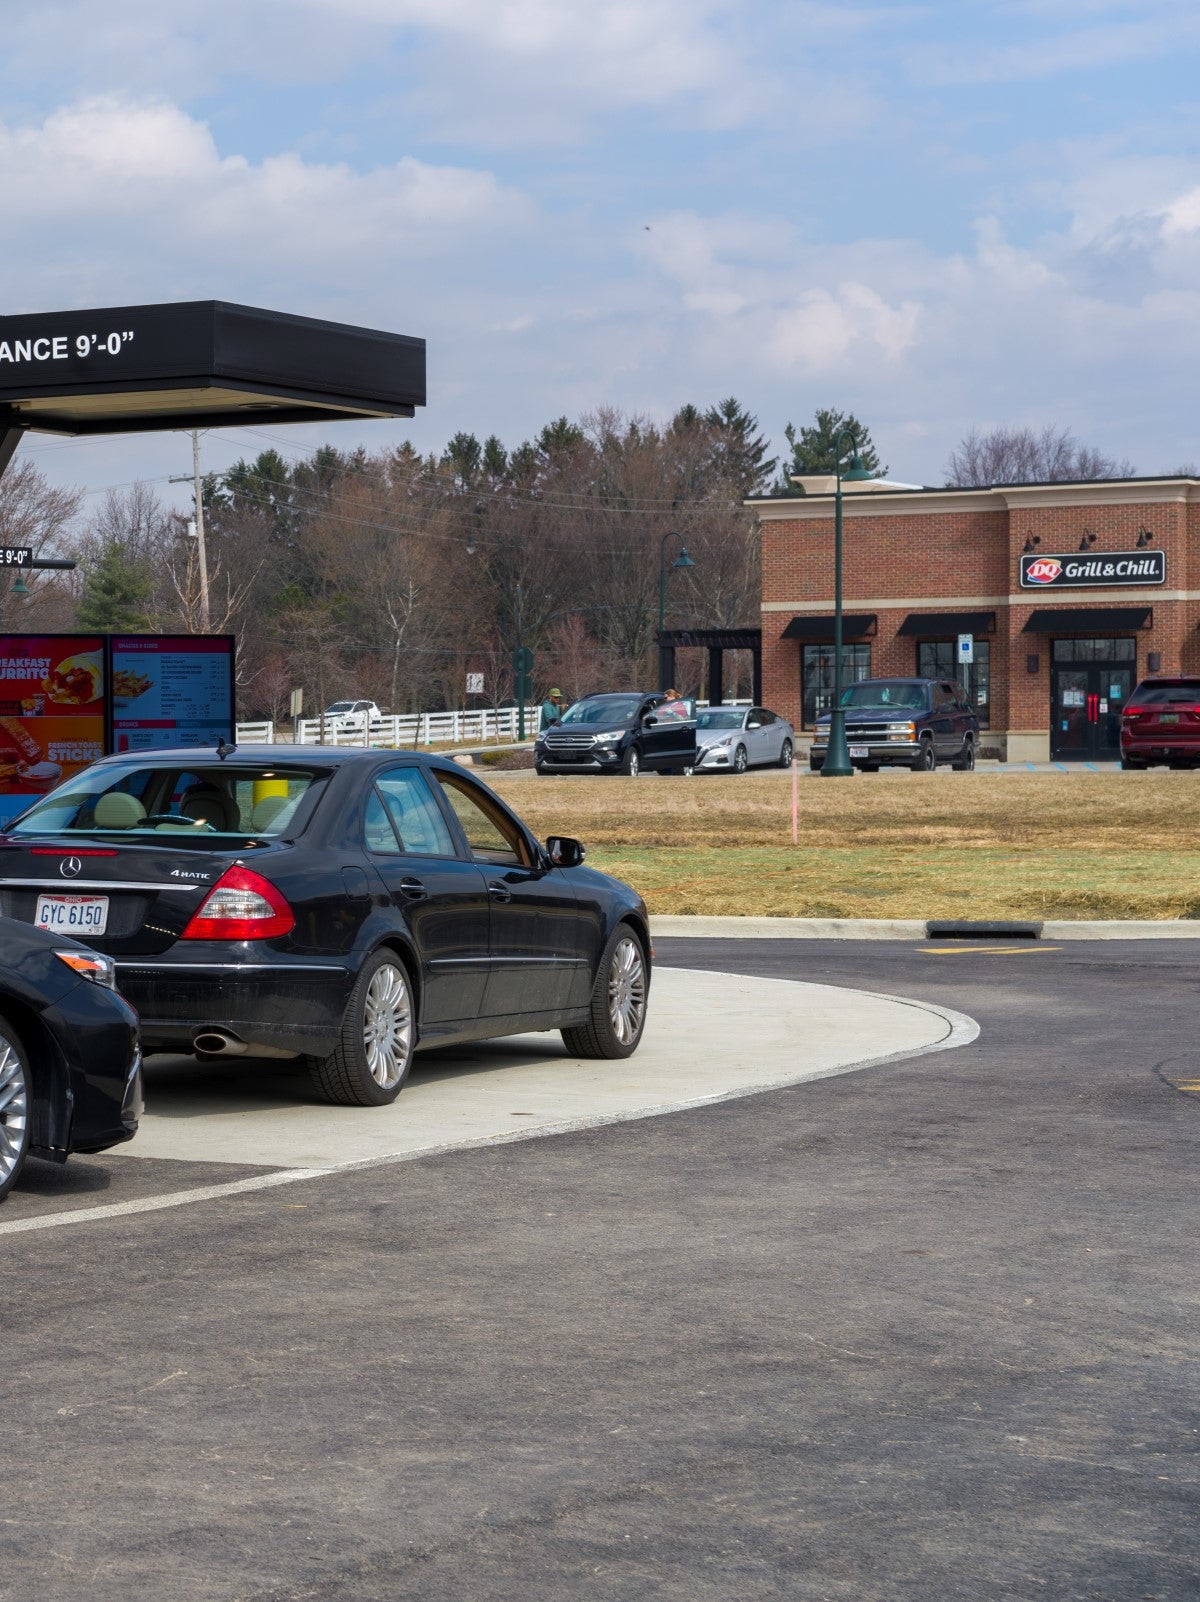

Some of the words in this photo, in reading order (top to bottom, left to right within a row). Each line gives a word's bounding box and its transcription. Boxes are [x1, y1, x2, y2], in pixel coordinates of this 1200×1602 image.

[1033, 563, 1057, 577] DQ
[78, 741, 103, 749] TOAST
[48, 748, 103, 761] STICKS
[41, 904, 66, 924] GYC
[69, 906, 102, 925] 6150
